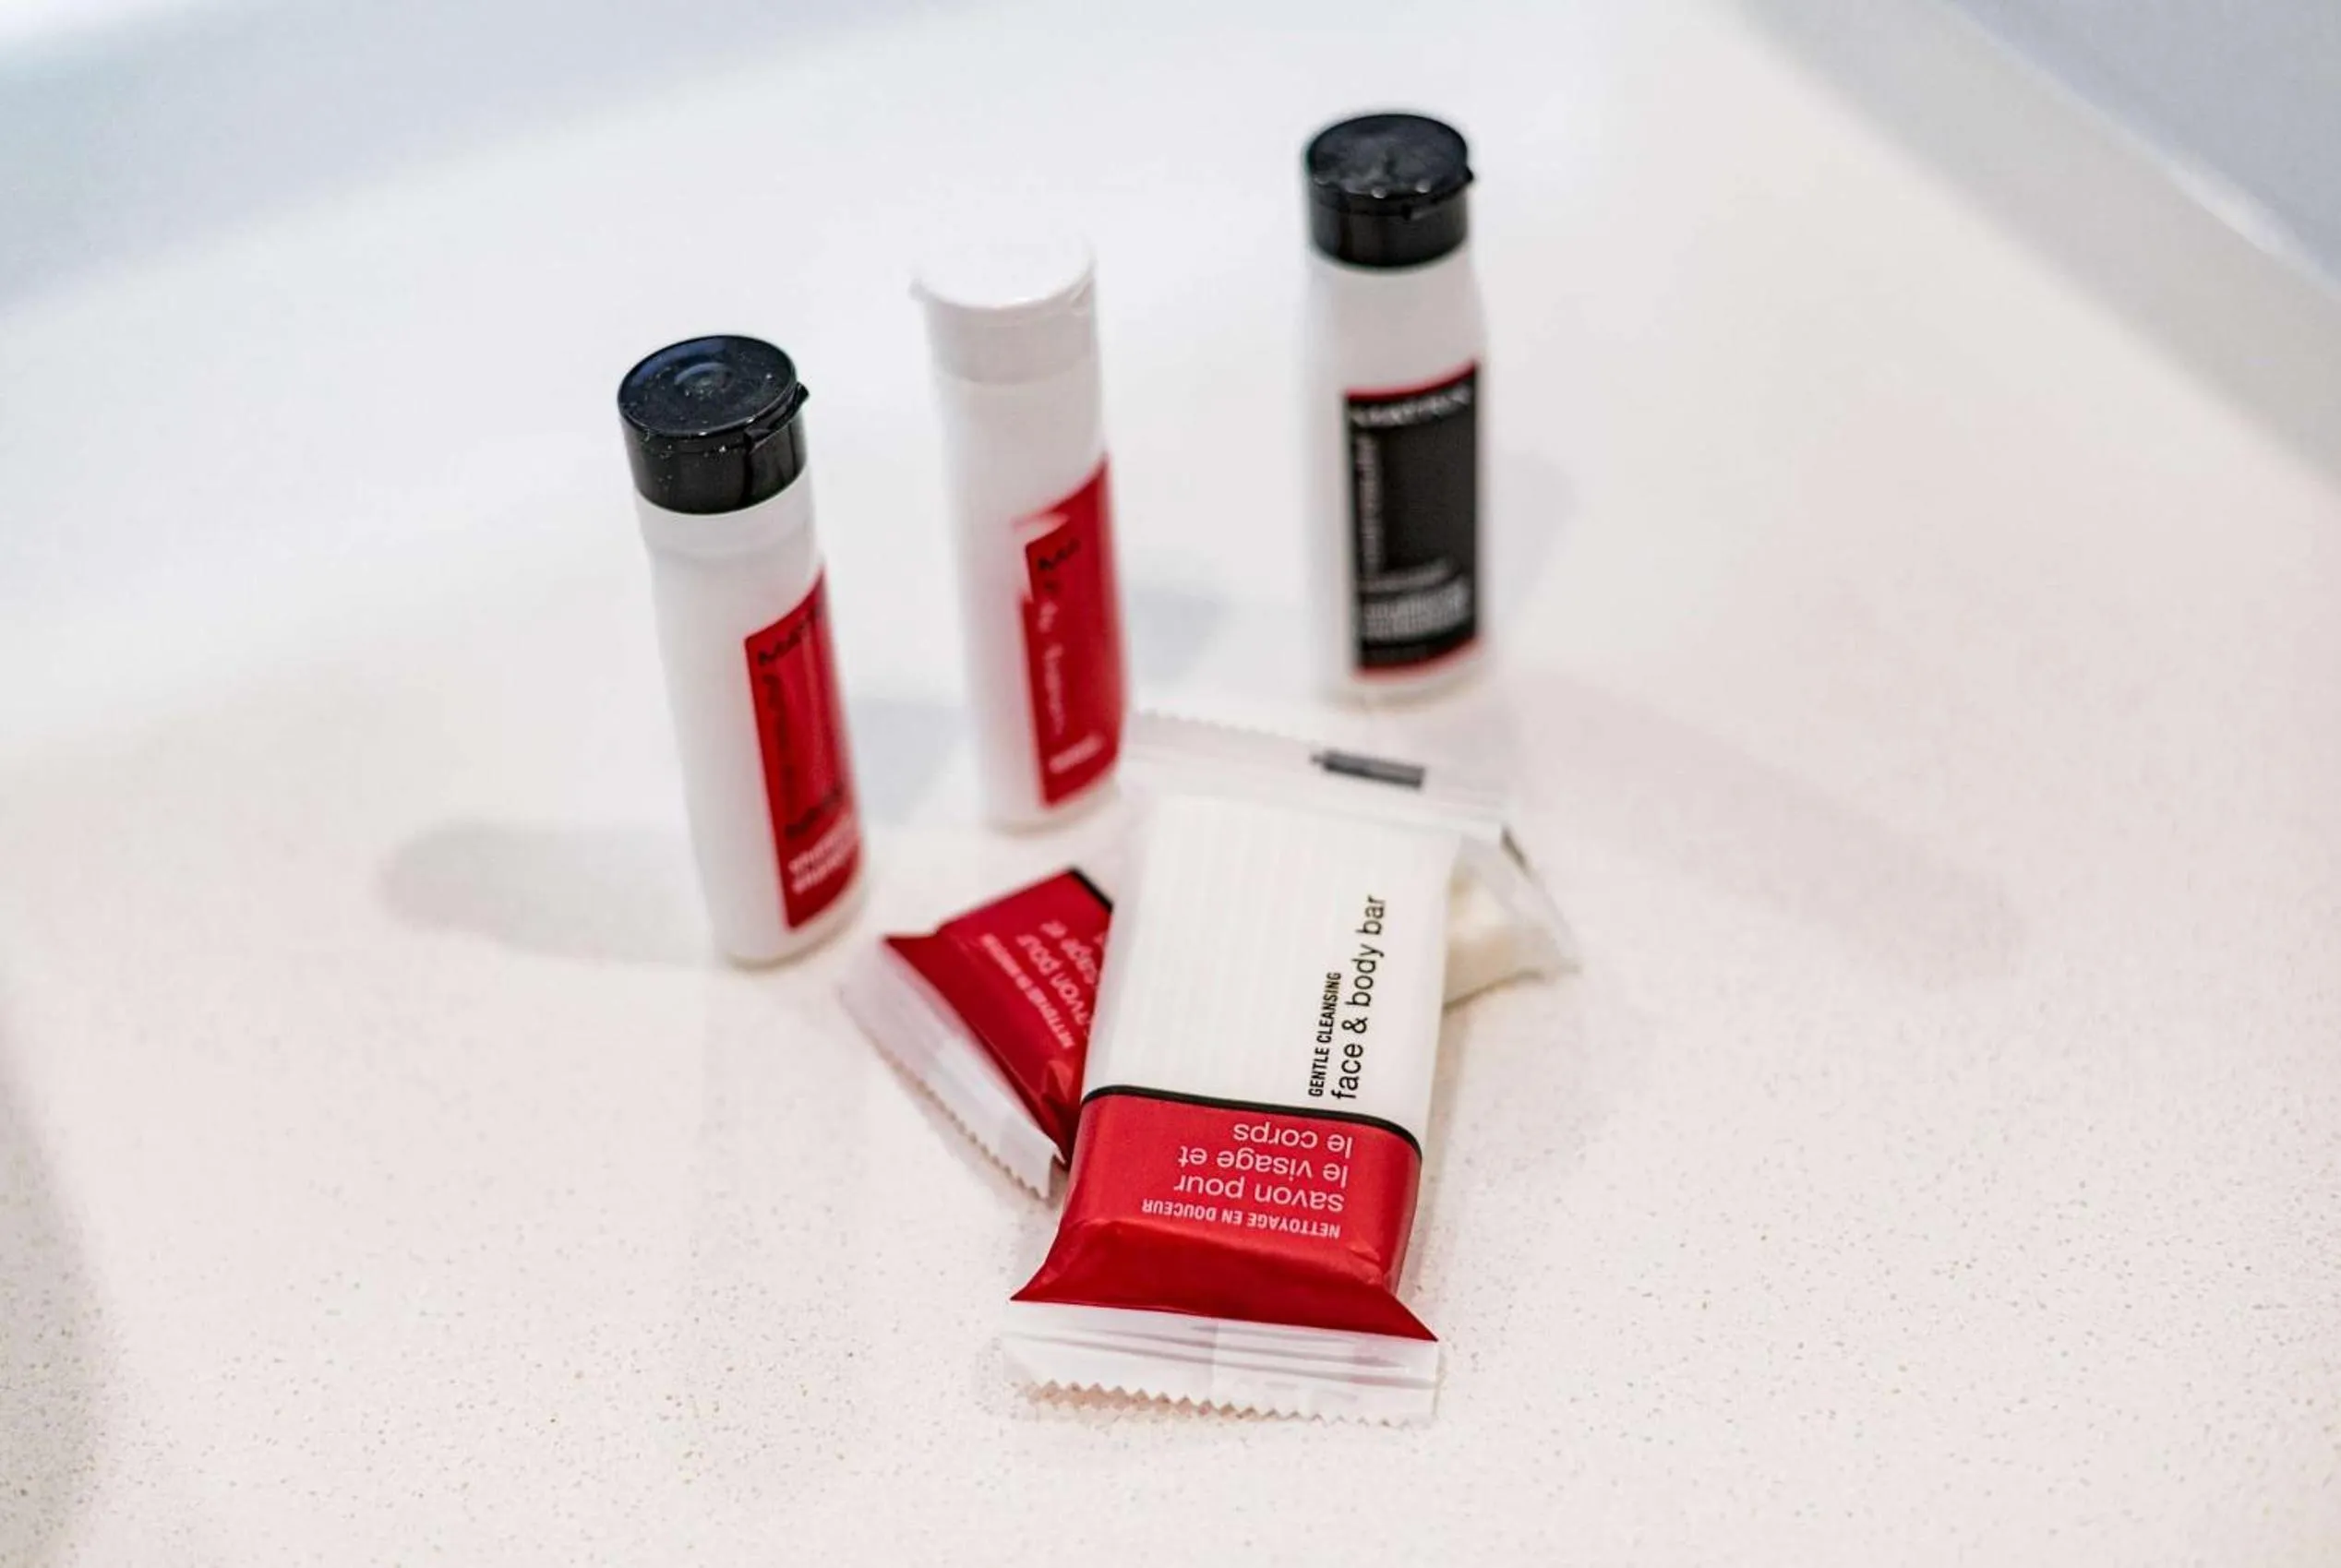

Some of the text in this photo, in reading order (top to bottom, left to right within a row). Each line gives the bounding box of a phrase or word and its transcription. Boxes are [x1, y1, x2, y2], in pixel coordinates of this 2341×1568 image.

[1049, 973, 1092, 1028] avon
[1330, 894, 1386, 1100] face & body bar
[1307, 972, 1342, 1098] GENTLE CLEANSING
[1232, 1120, 1353, 1159] le corps
[1177, 1145, 1349, 1189] le visage et
[1173, 1175, 1345, 1213] savon pour
[1142, 1199, 1341, 1239] NETTOYAGE EN DOUCEUR
